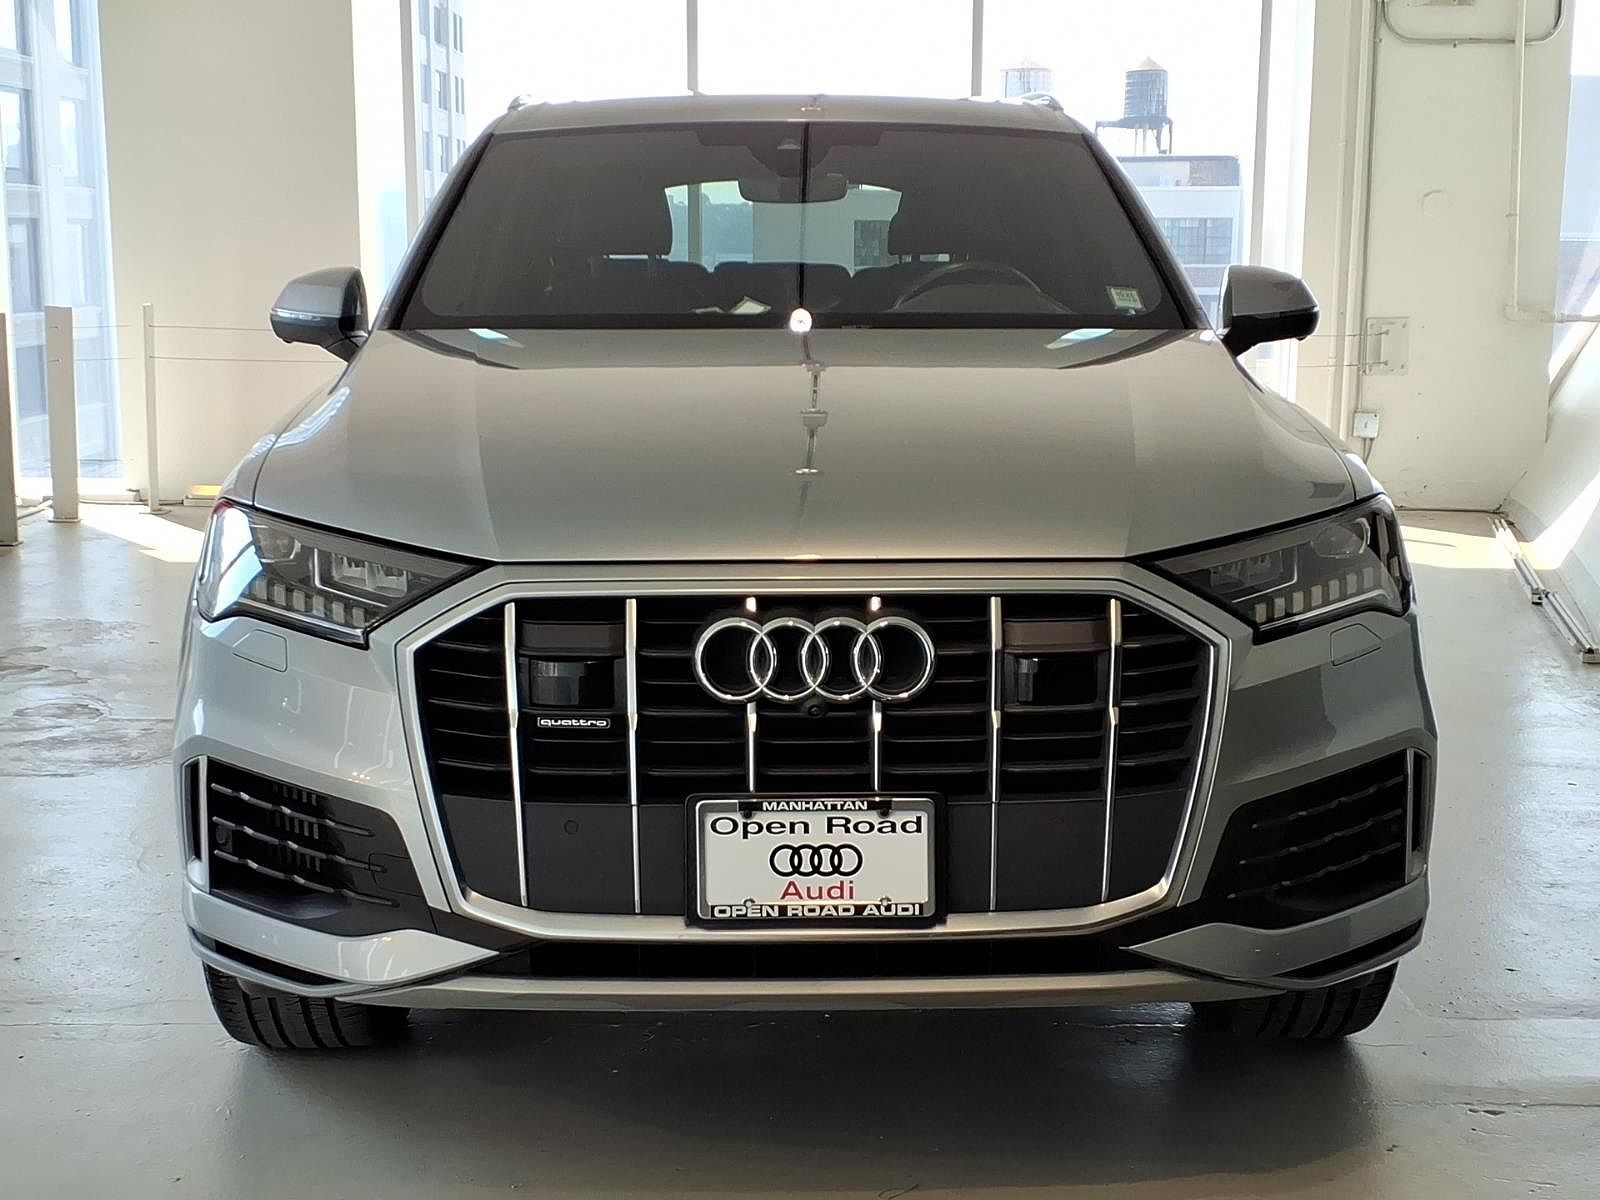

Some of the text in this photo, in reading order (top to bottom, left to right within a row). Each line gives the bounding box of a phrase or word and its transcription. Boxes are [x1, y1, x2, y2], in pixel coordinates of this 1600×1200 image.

[540, 719, 607, 728] quattro
[762, 801, 868, 811] MANHATTAN
[710, 816, 923, 839] Open Road
[780, 880, 855, 900] Audi
[713, 904, 920, 918] OPEN ROAD AUDI
